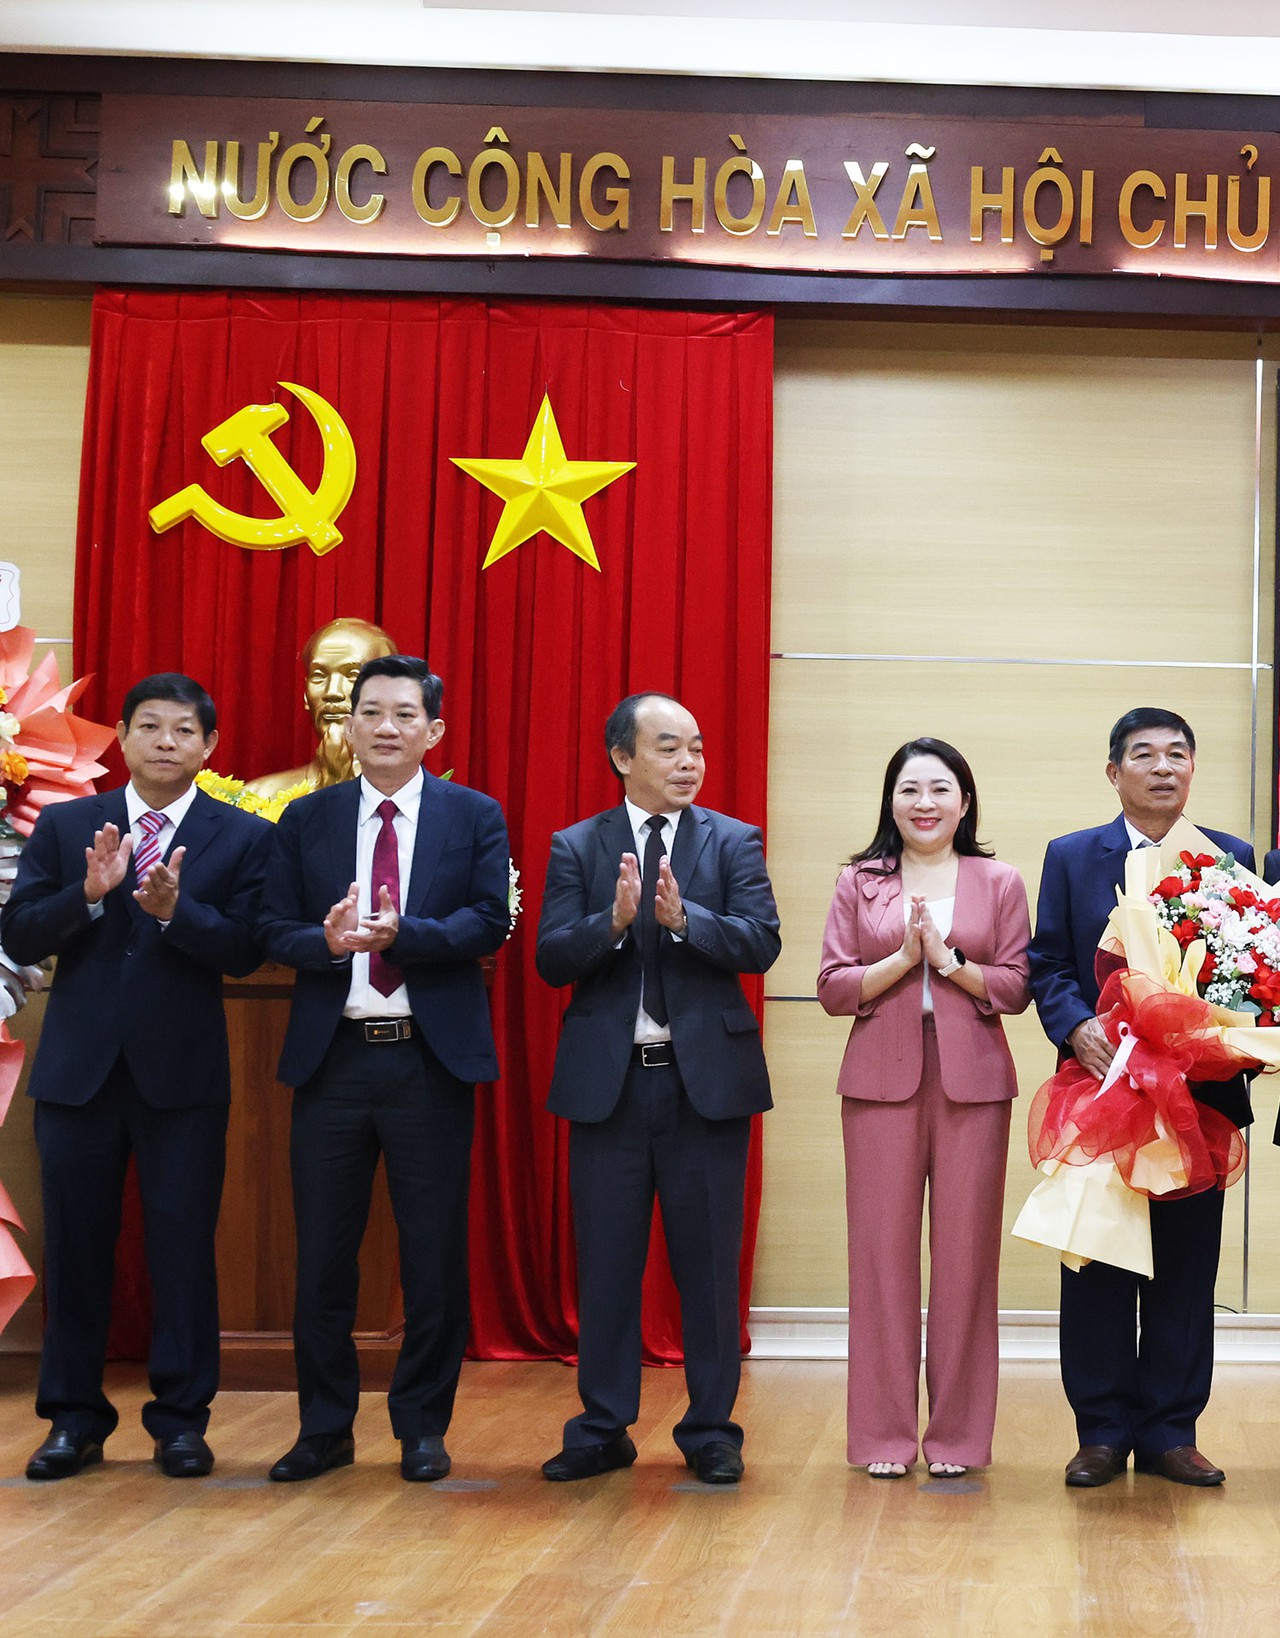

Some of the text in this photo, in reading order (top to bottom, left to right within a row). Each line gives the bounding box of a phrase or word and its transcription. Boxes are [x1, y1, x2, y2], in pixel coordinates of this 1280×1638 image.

[169, 117, 388, 224] NƯỚC
[411, 126, 632, 246] CỘNG
[659, 133, 819, 238] HÒA
[841, 142, 943, 242] XÃ
[968, 147, 1093, 262] HỘI
[1118, 144, 1272, 253] CHỦ
